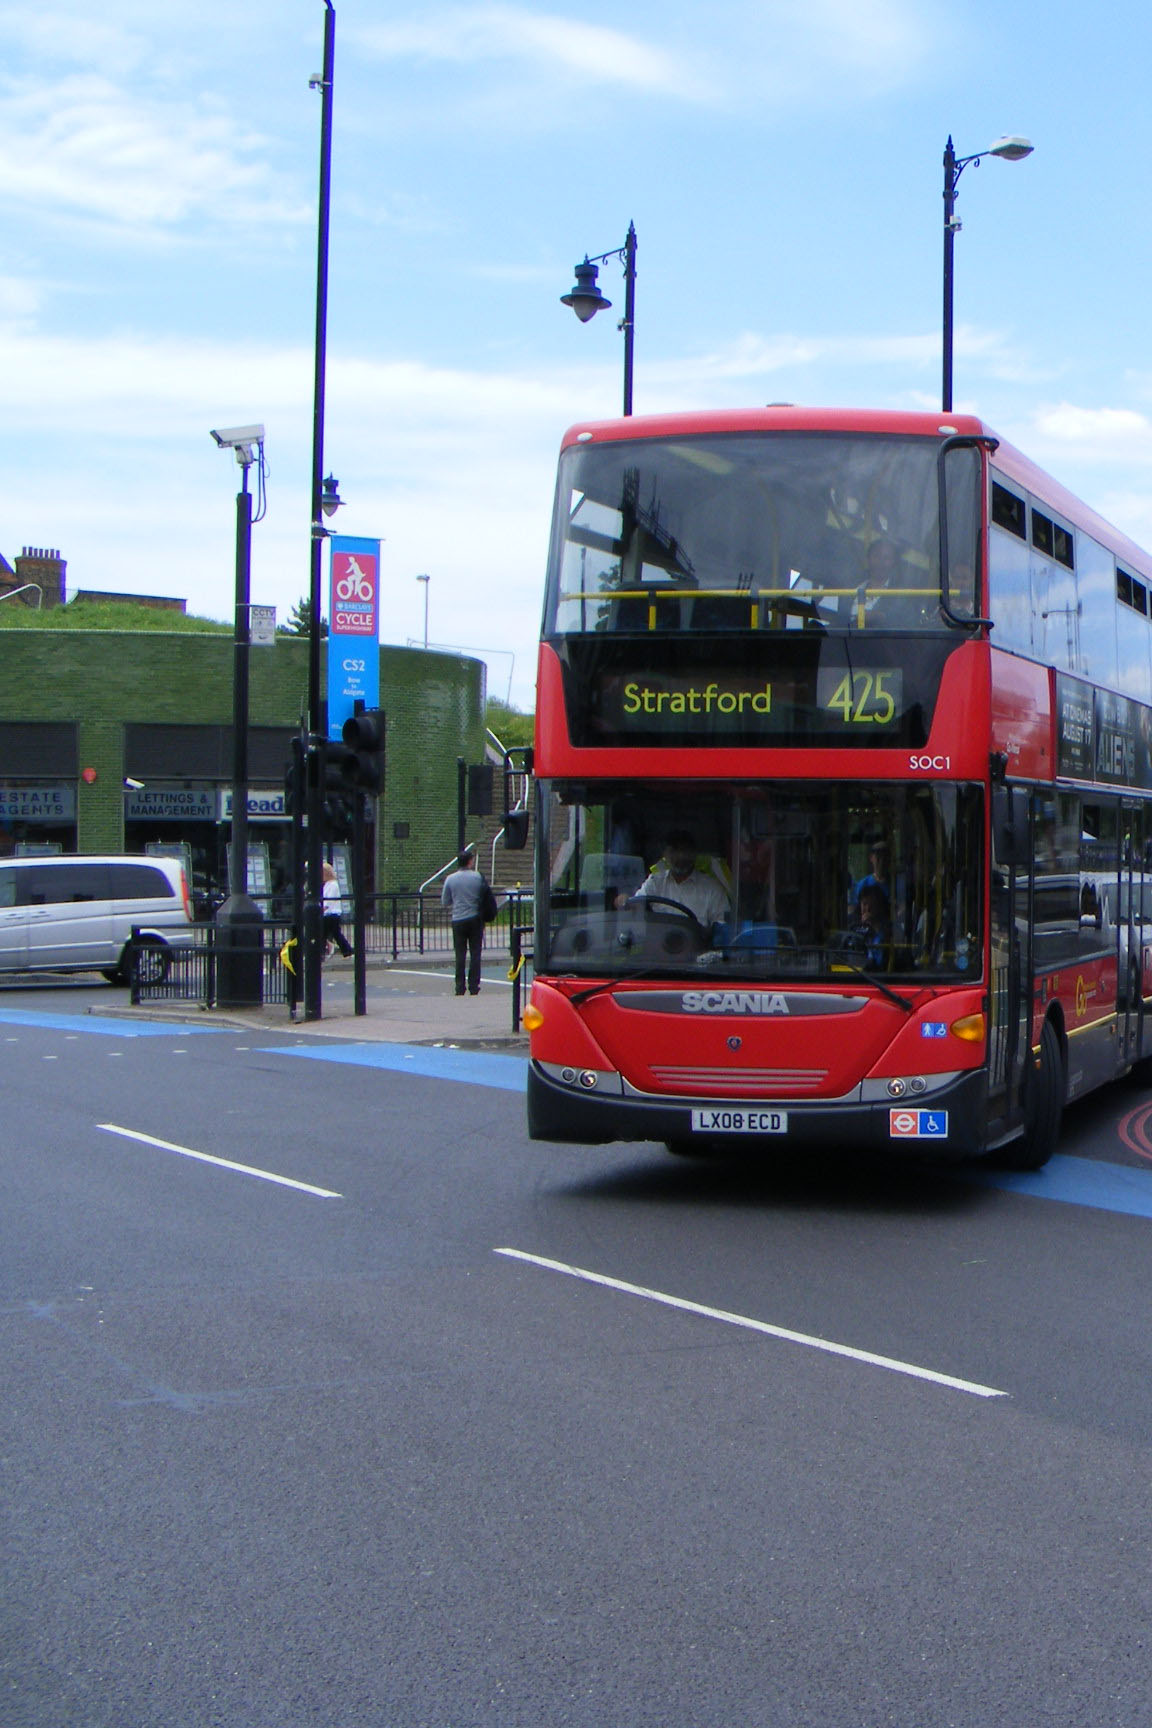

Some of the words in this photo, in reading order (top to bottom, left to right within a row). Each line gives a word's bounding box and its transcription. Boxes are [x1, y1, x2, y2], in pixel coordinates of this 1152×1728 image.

[253, 609, 275, 617] CCTV
[336, 612, 373, 626] CYCLE
[342, 659, 366, 672] CS2
[623, 683, 772, 713] Stratford
[828, 672, 896, 724] 425
[909, 755, 951, 770] SOC1
[0, 791, 61, 803] ESTATE
[138, 793, 194, 804] LETTINGS
[199, 793, 209, 804] &
[0, 804, 64, 815] AGENTS
[130, 805, 213, 816] MANAGEMENT
[682, 992, 790, 1013] SCANIA
[700, 1112, 743, 1129] LX08
[748, 1113, 781, 1131] ECD
